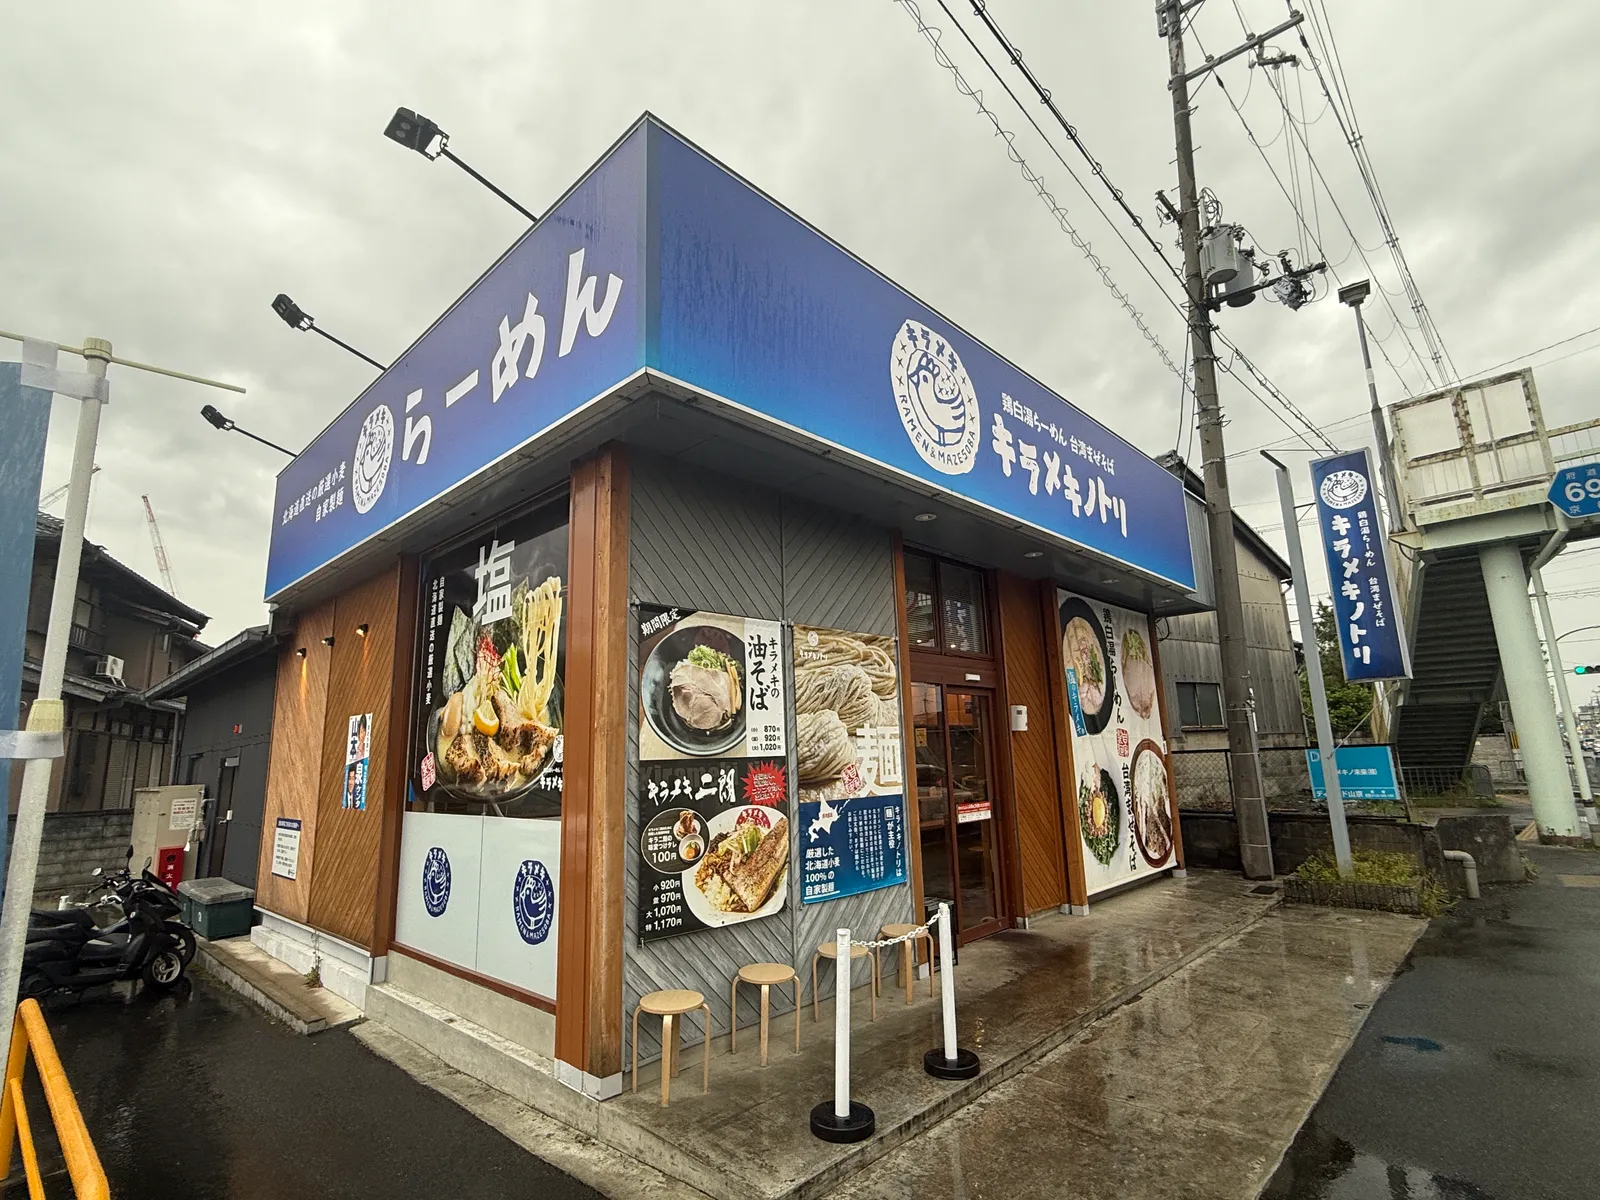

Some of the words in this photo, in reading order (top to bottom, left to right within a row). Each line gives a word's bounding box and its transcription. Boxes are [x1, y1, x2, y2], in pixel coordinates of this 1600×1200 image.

[402, 247, 623, 465] らーめん
[905, 322, 958, 373] キラメキ
[1001, 392, 1068, 447] 鶏白湯らーめん
[1069, 435, 1115, 476] 台湾まぜそば
[991, 412, 1128, 538] キラメキノトリ
[1565, 478, 1600, 502] 69
[315, 486, 345, 523] 自家製麺
[472, 539, 515, 626] 塩
[1356, 510, 1376, 567] 鶏白湯らーめん
[1368, 576, 1386, 627] 台湾まぜそば
[1331, 514, 1371, 665] キラメキノトリ
[640, 607, 682, 637] 期間限定
[747, 634, 770, 711] 油そば
[768, 637, 780, 699] キラメキの
[652, 851, 677, 864] 100円
[805, 846, 834, 859] 厳選した
[894, 806, 902, 877] キラメキノトリは
[805, 857, 841, 871] 北海道小麦
[652, 884, 660, 892] 小
[660, 879, 681, 891] 920円
[660, 892, 681, 903] 970円
[805, 882, 835, 896] 自家製麺
[645, 910, 653, 919] 大
[654, 904, 682, 918] 1,070円
[654, 917, 682, 931] 1,170円
